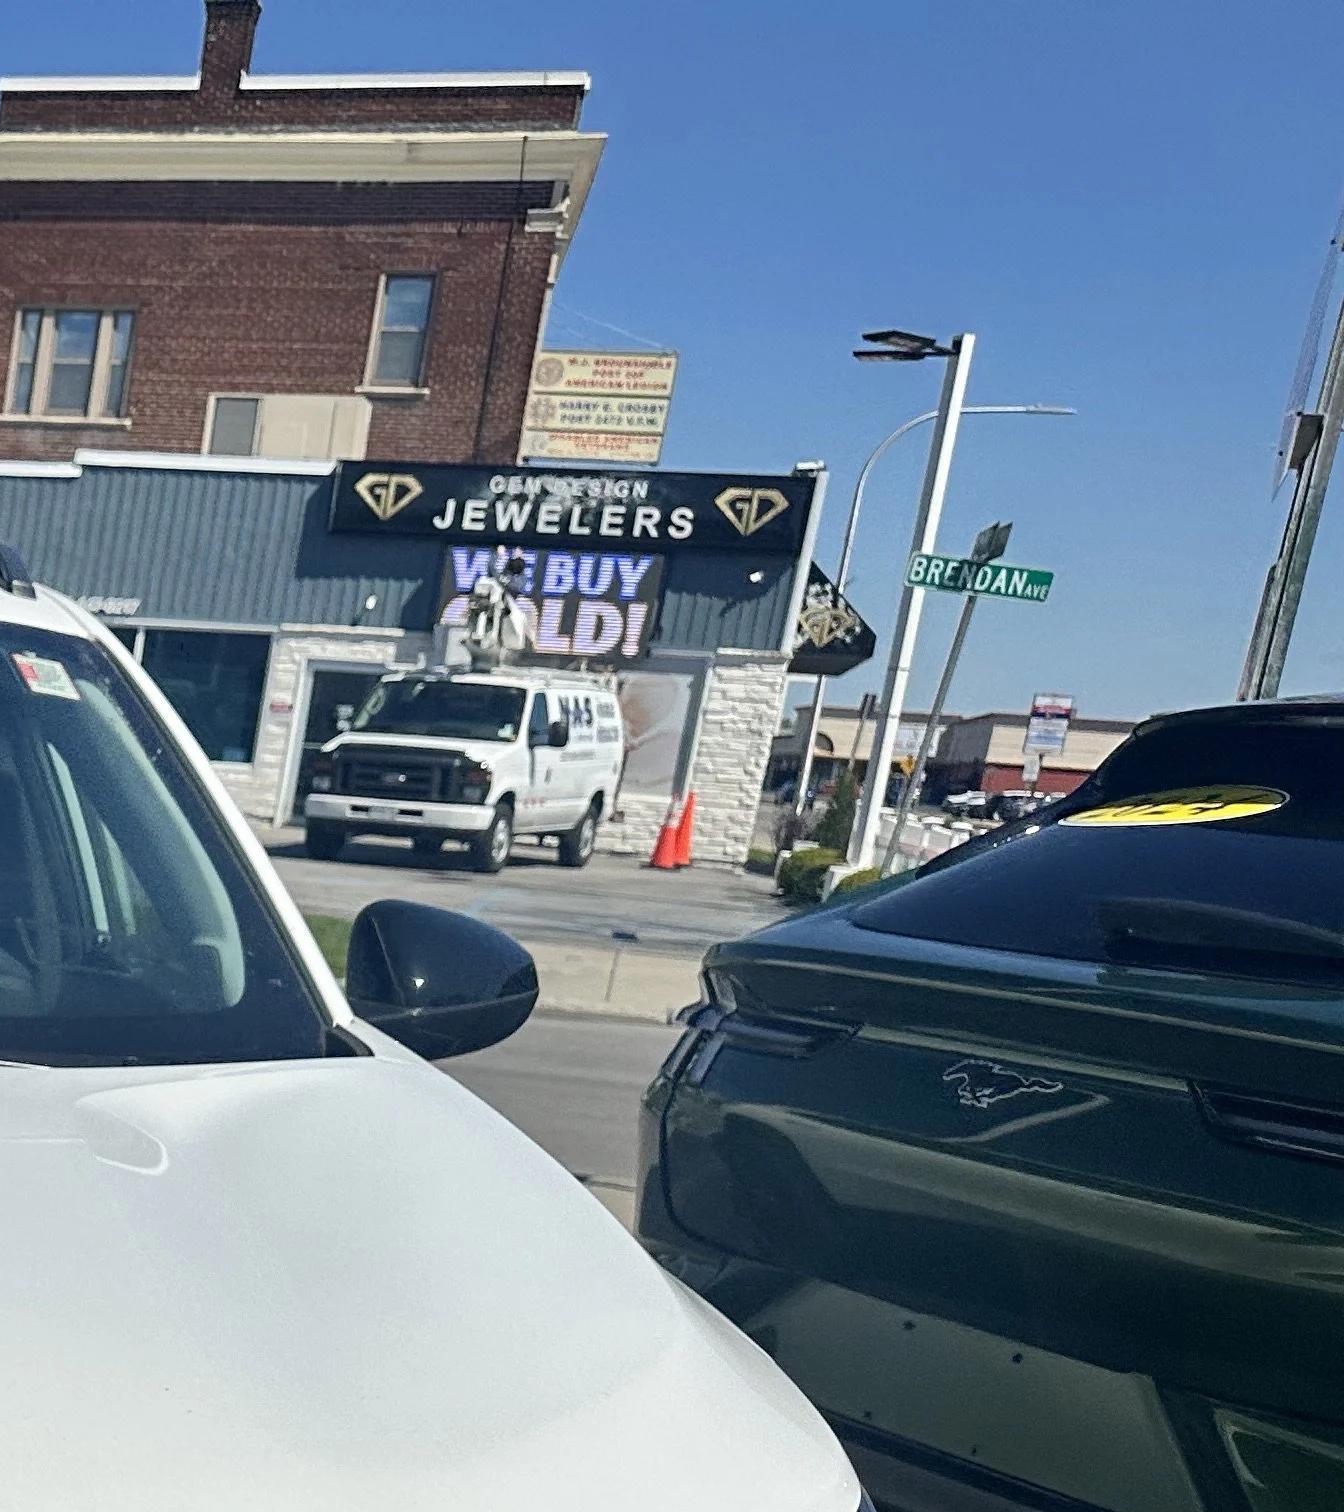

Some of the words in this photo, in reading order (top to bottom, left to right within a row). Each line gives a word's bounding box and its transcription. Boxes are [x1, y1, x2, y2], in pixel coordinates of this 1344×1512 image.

[553, 477, 649, 500] DESIGN
[433, 498, 694, 539] JEWELERS
[541, 550, 654, 601] BUY
[909, 556, 1028, 597] BRENDAN
[1023, 584, 1049, 600] AVE
